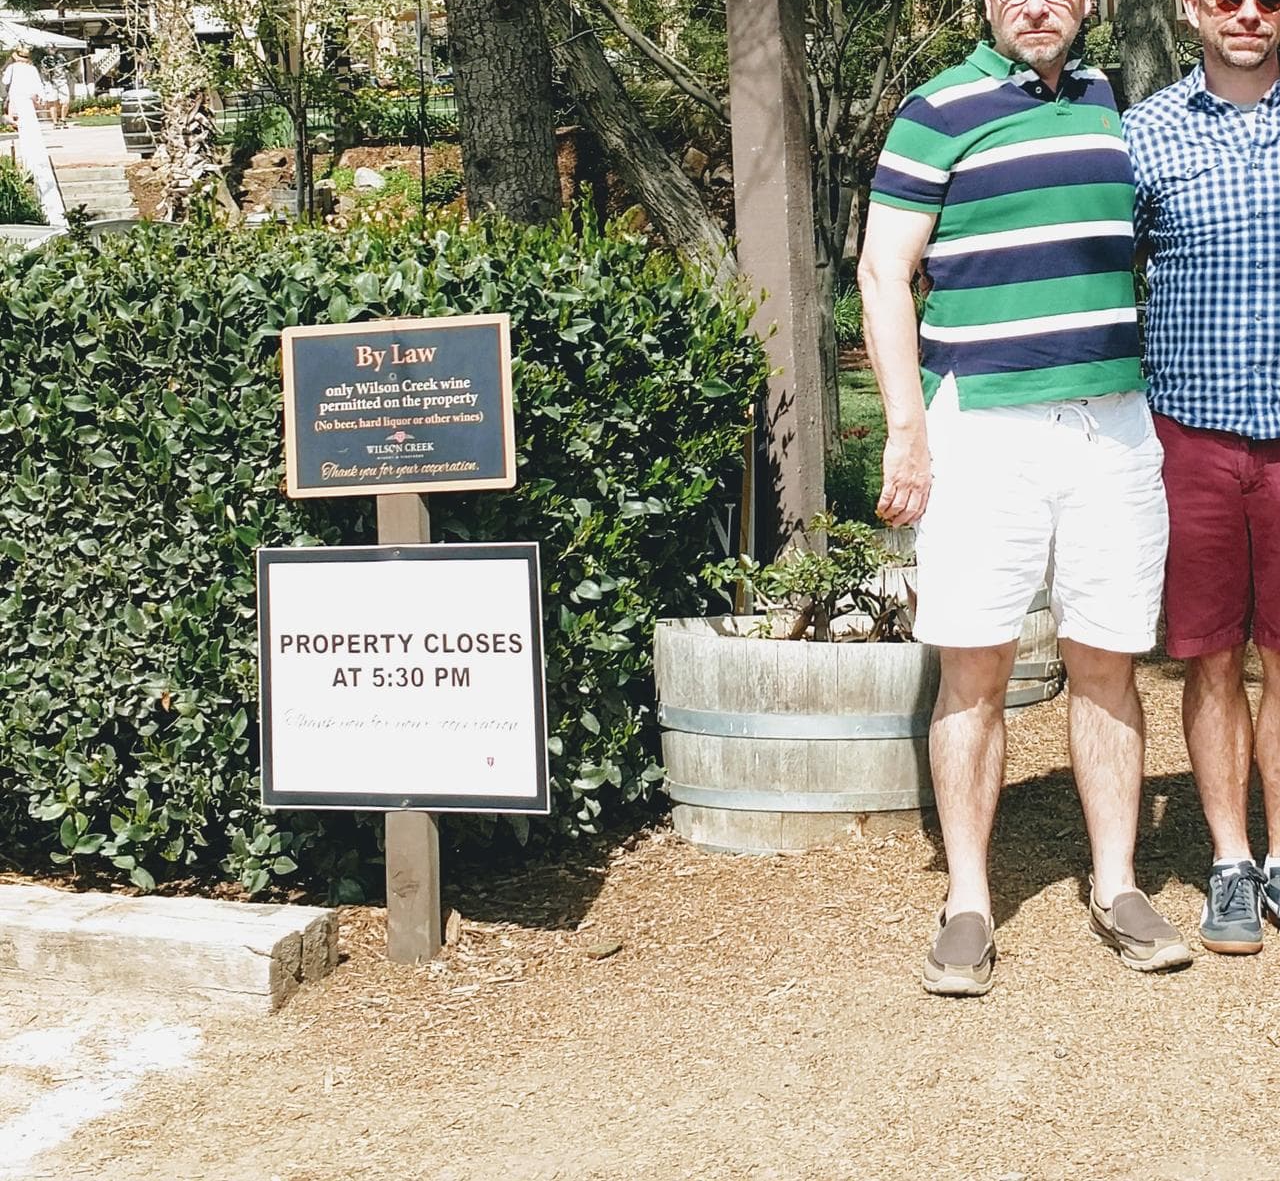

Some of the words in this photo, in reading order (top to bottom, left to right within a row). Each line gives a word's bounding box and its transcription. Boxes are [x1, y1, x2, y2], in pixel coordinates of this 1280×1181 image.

[356, 345, 387, 371] By
[391, 343, 437, 366] Law
[325, 383, 354, 398] only
[355, 382, 400, 395] Wilson
[402, 379, 438, 392] Creek
[440, 377, 471, 389] wine
[319, 397, 381, 415] permitted
[384, 398, 400, 408] on
[402, 396, 421, 407] the
[423, 393, 479, 409] property
[314, 421, 333, 432] (No
[334, 419, 357, 431] beer,
[359, 418, 382, 429] hard
[384, 416, 411, 430] liquor
[413, 417, 423, 426] or
[424, 414, 451, 425] other
[452, 411, 484, 423] wines)
[366, 443, 403, 454] WILSON
[404, 442, 434, 452] CREEK
[321, 461, 358, 481] Thank
[358, 465, 378, 480] you
[376, 462, 395, 480] for
[396, 464, 420, 478] your
[280, 633, 413, 654] PROPERTY
[423, 632, 524, 654] CLOSES
[332, 667, 361, 687] AT
[372, 667, 424, 687] 5:30
[435, 667, 471, 687] PM
